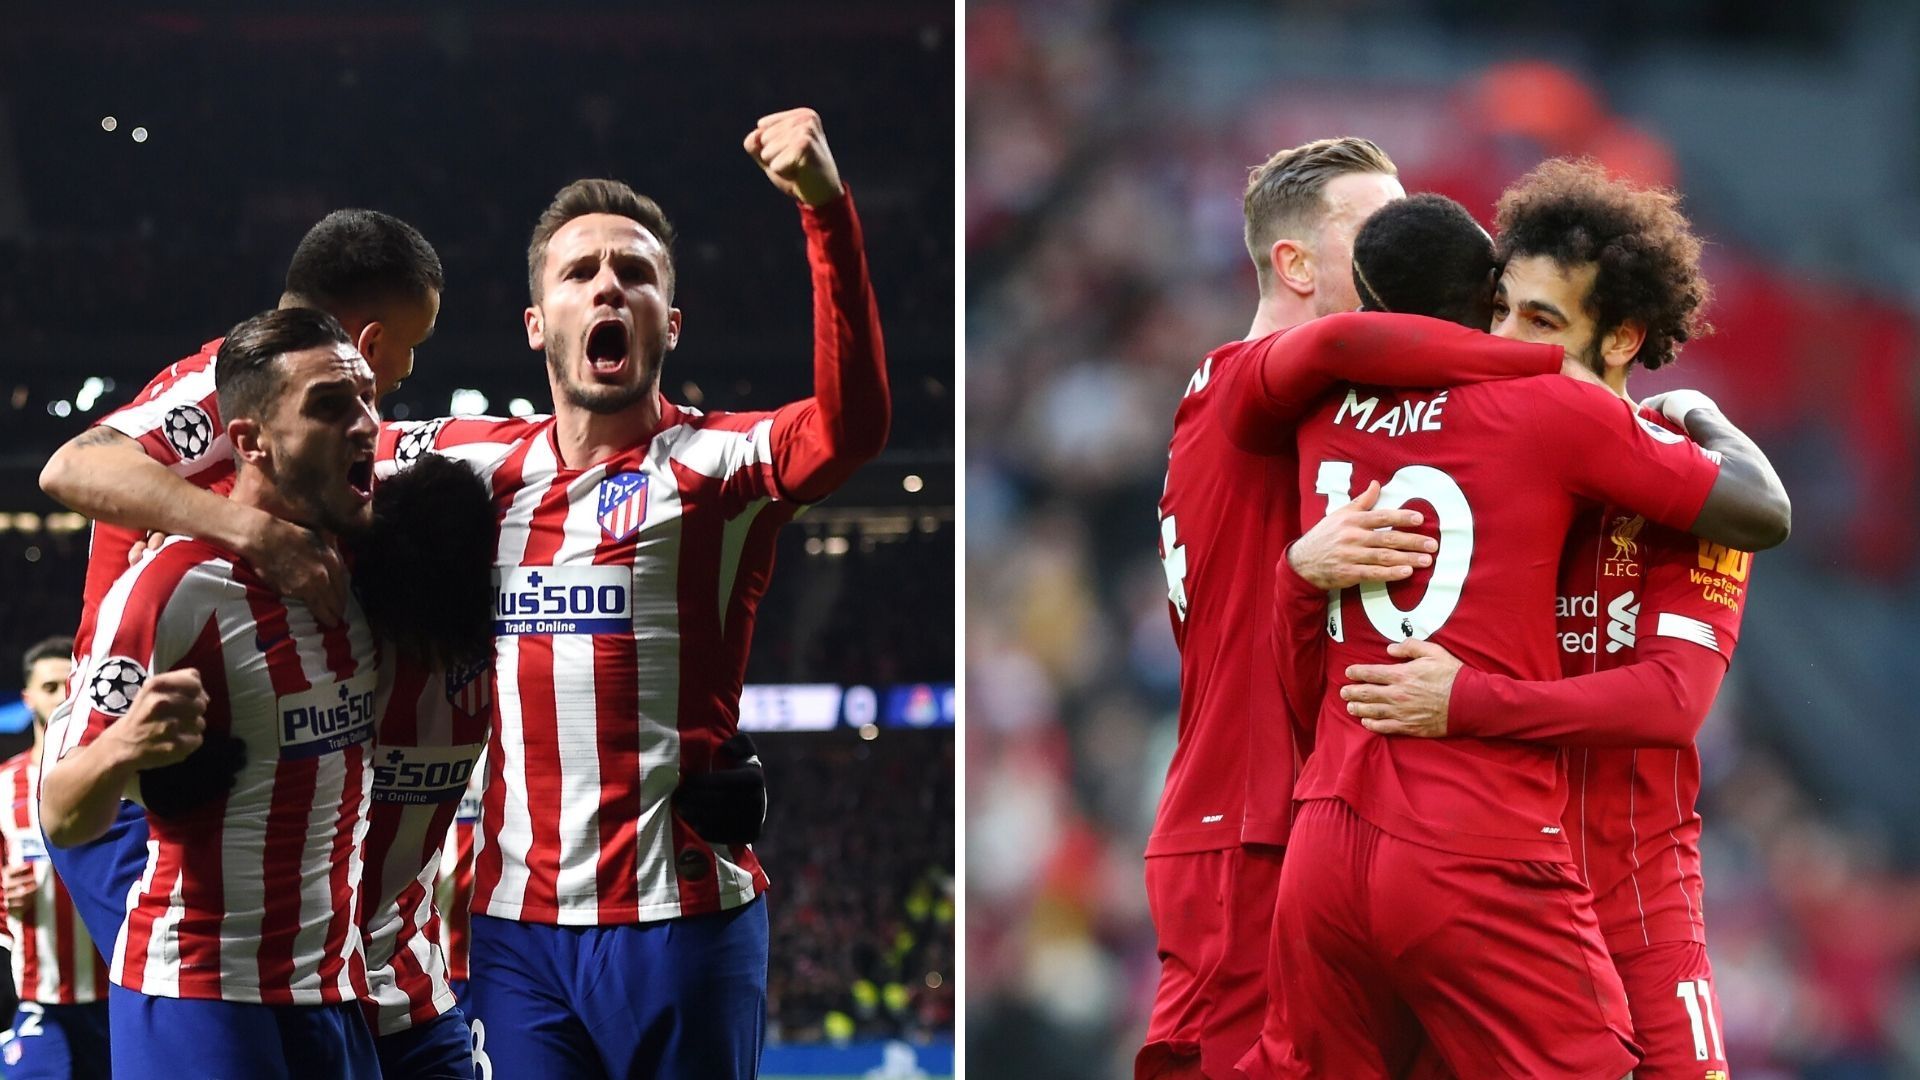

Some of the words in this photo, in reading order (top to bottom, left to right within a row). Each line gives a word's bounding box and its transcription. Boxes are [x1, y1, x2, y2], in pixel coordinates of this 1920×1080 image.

[1333, 389, 1448, 437] MANÉ
[1316, 461, 1475, 644] 10
[1690, 568, 1743, 598] Western
[1702, 585, 1739, 615] Union
[505, 621, 532, 634] Trade
[535, 621, 576, 633] Online
[17, 1001, 45, 1037] 2
[1677, 978, 1724, 1061] 11
